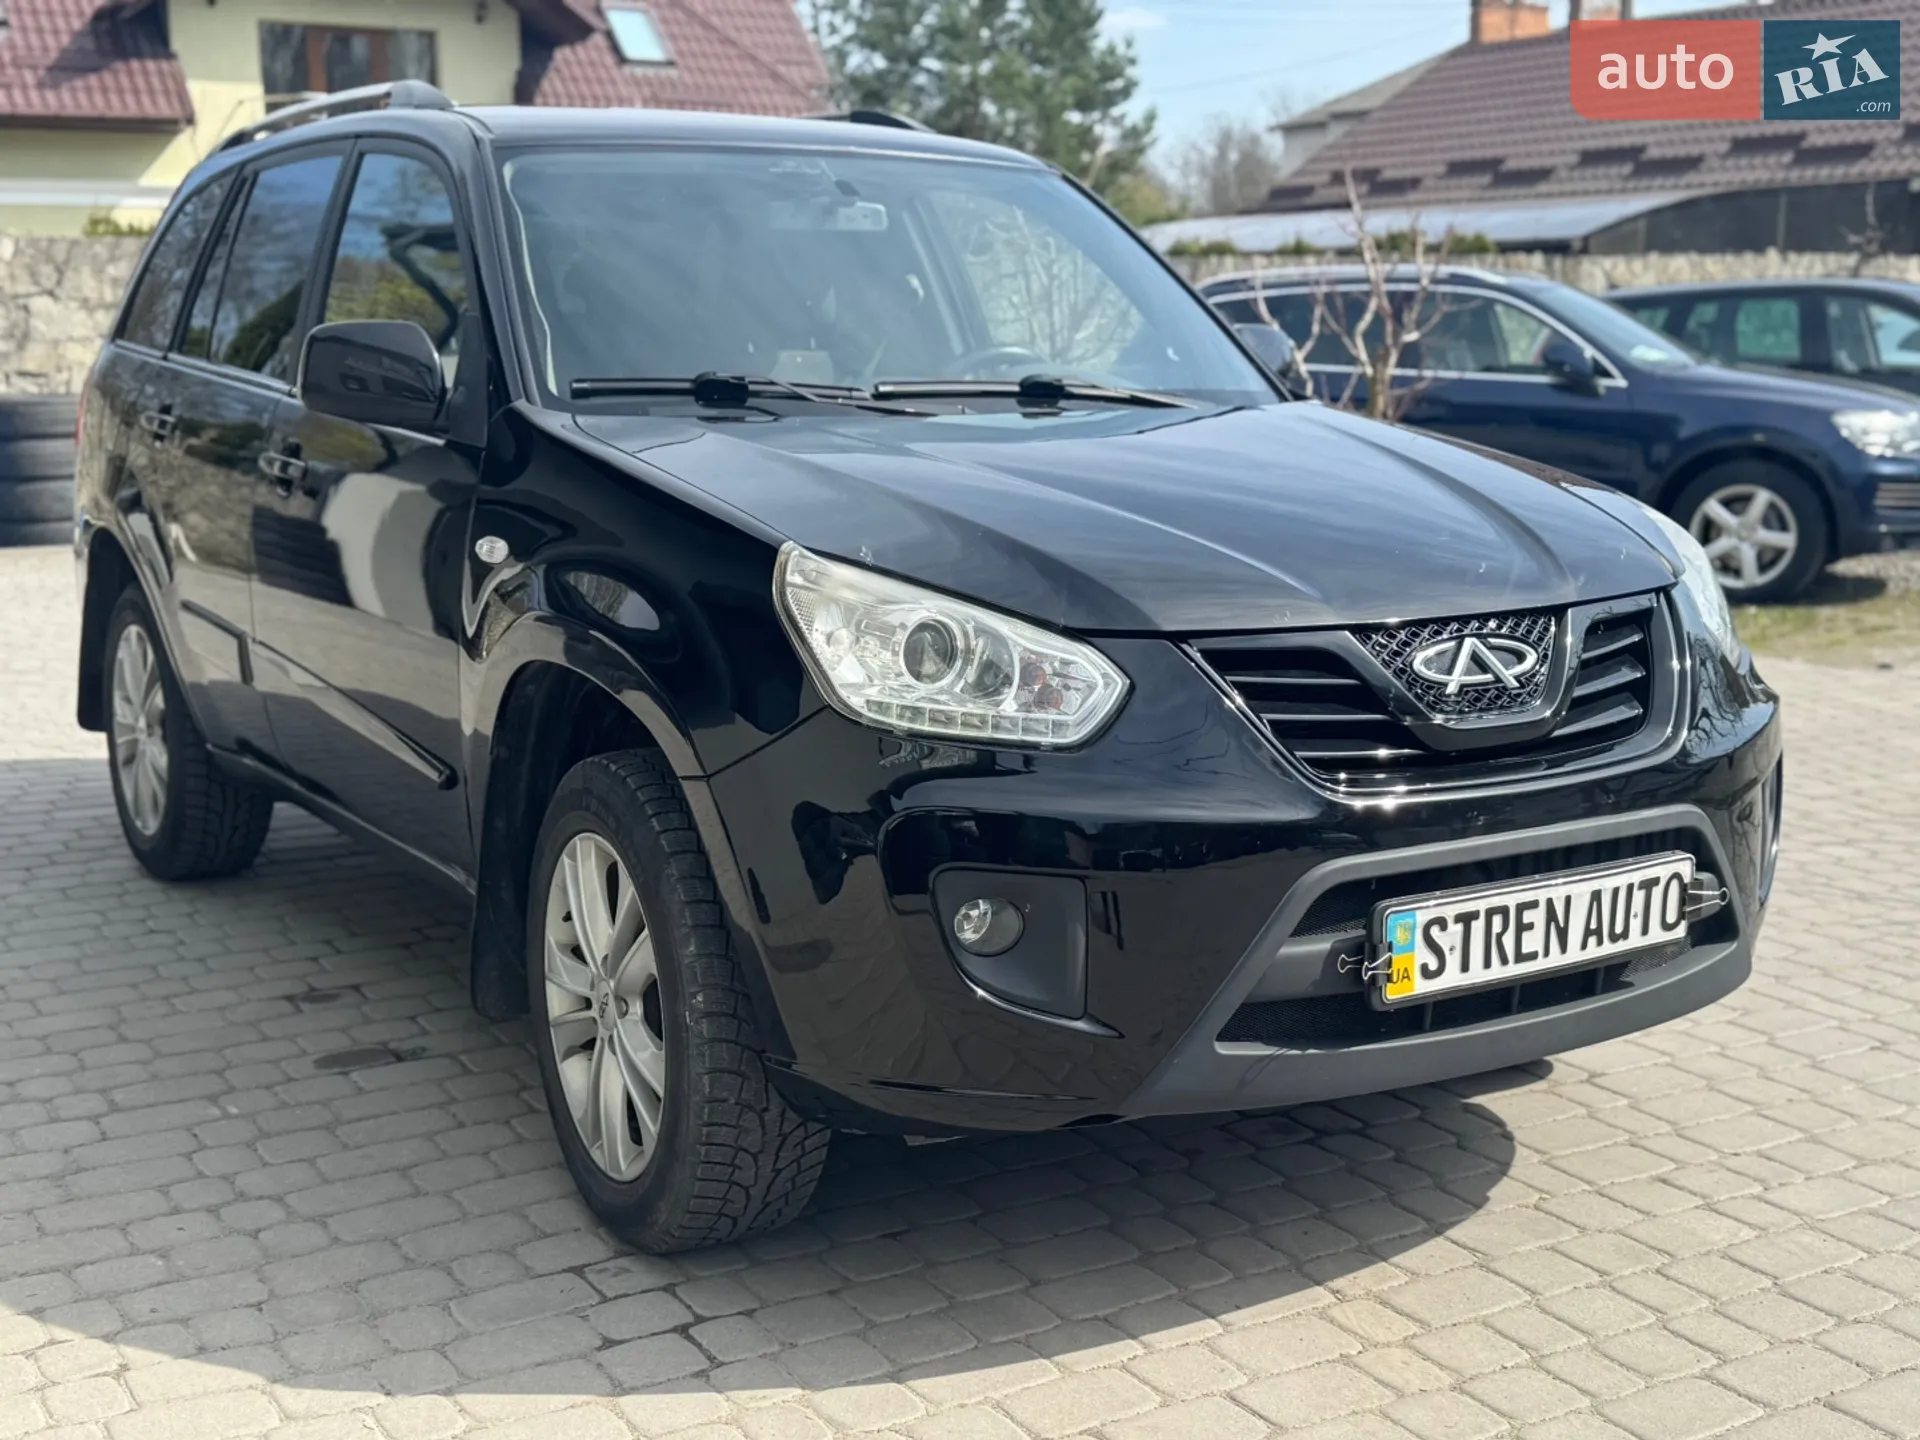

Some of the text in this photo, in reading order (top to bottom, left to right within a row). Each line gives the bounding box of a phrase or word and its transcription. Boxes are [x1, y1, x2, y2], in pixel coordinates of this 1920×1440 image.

[1420, 871, 1687, 980] STREN AUTO
[1391, 967, 1411, 984] UA
